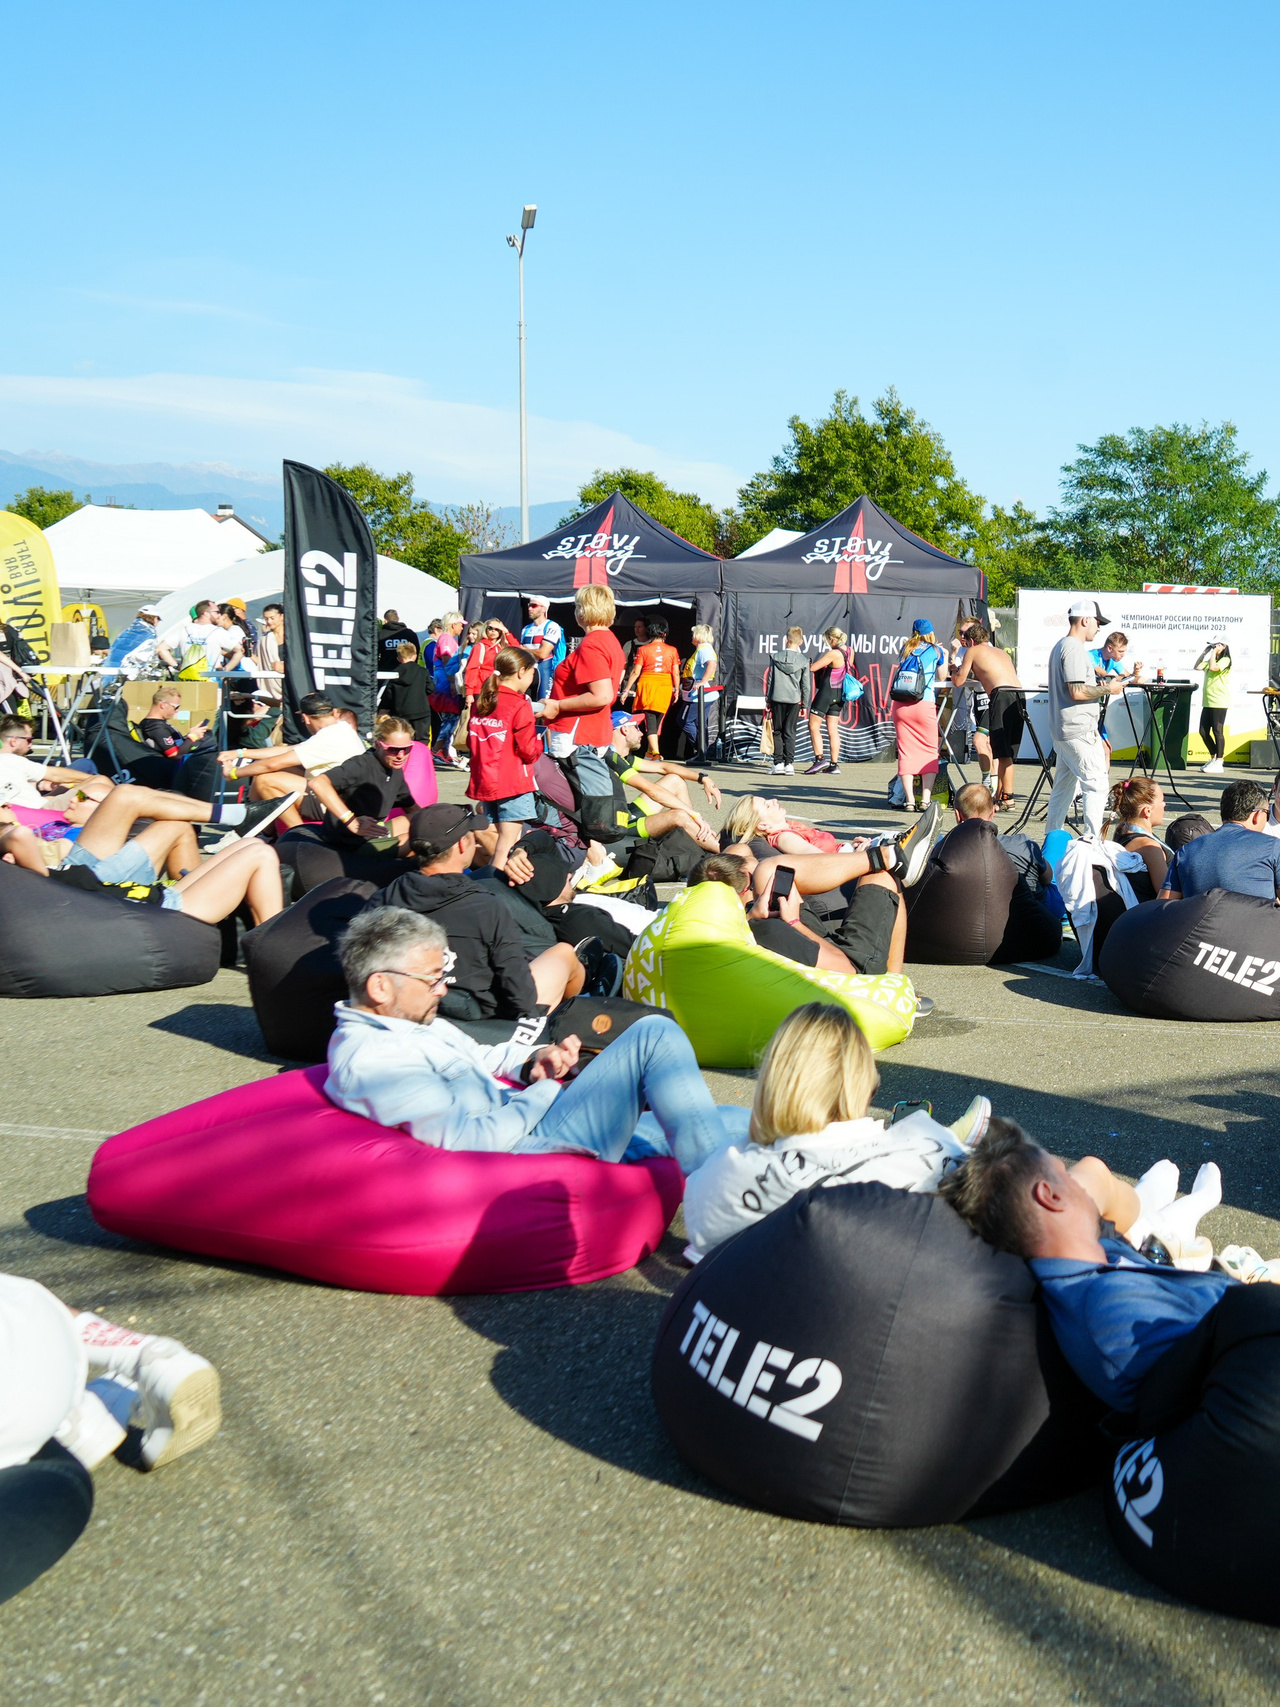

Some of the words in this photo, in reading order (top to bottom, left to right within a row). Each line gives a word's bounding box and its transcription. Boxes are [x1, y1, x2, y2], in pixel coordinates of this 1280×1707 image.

[300, 549, 357, 691] TELE2
[1121, 614, 1162, 622] ЧЕМПИОНАТ
[1193, 615, 1202, 623] ПО
[1132, 622, 1166, 630] ДЛИННОЙ
[1168, 623, 1209, 631] ДИСТАНЦИИ
[759, 634, 779, 653] НЕ
[851, 634, 876, 654] МЫ
[470, 717, 503, 728] МОСКВА
[679, 1300, 843, 1443] TELE2
